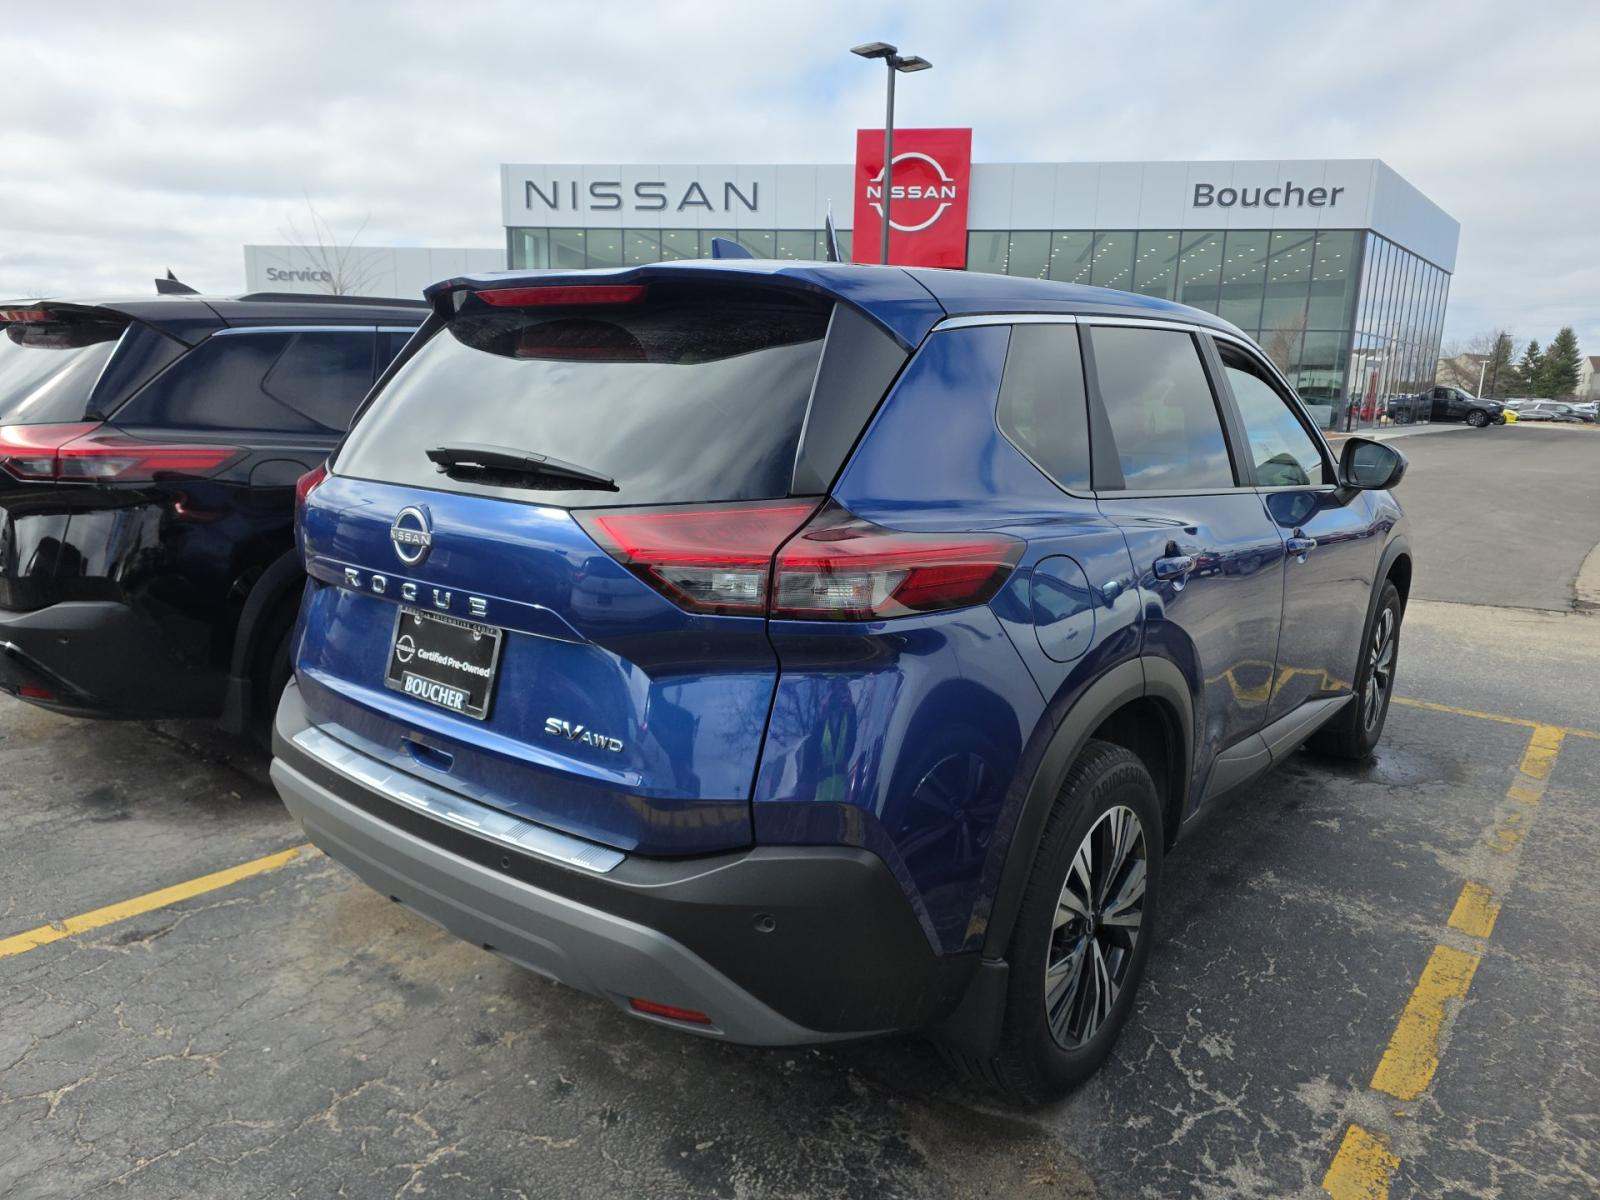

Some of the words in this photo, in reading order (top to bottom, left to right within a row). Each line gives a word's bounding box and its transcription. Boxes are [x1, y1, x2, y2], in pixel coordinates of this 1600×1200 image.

[525, 180, 759, 212] NISSAN
[867, 185, 956, 199] NSSAN
[1192, 181, 1345, 208] Boucher
[266, 267, 332, 282] Service
[391, 528, 431, 546] NISSAN
[344, 567, 488, 618] ROGUE
[417, 648, 448, 666] Certified
[448, 658, 490, 678] Pre-Owned
[405, 675, 464, 709] BOUCHER
[544, 717, 584, 741] SV
[579, 731, 624, 753] AWD
